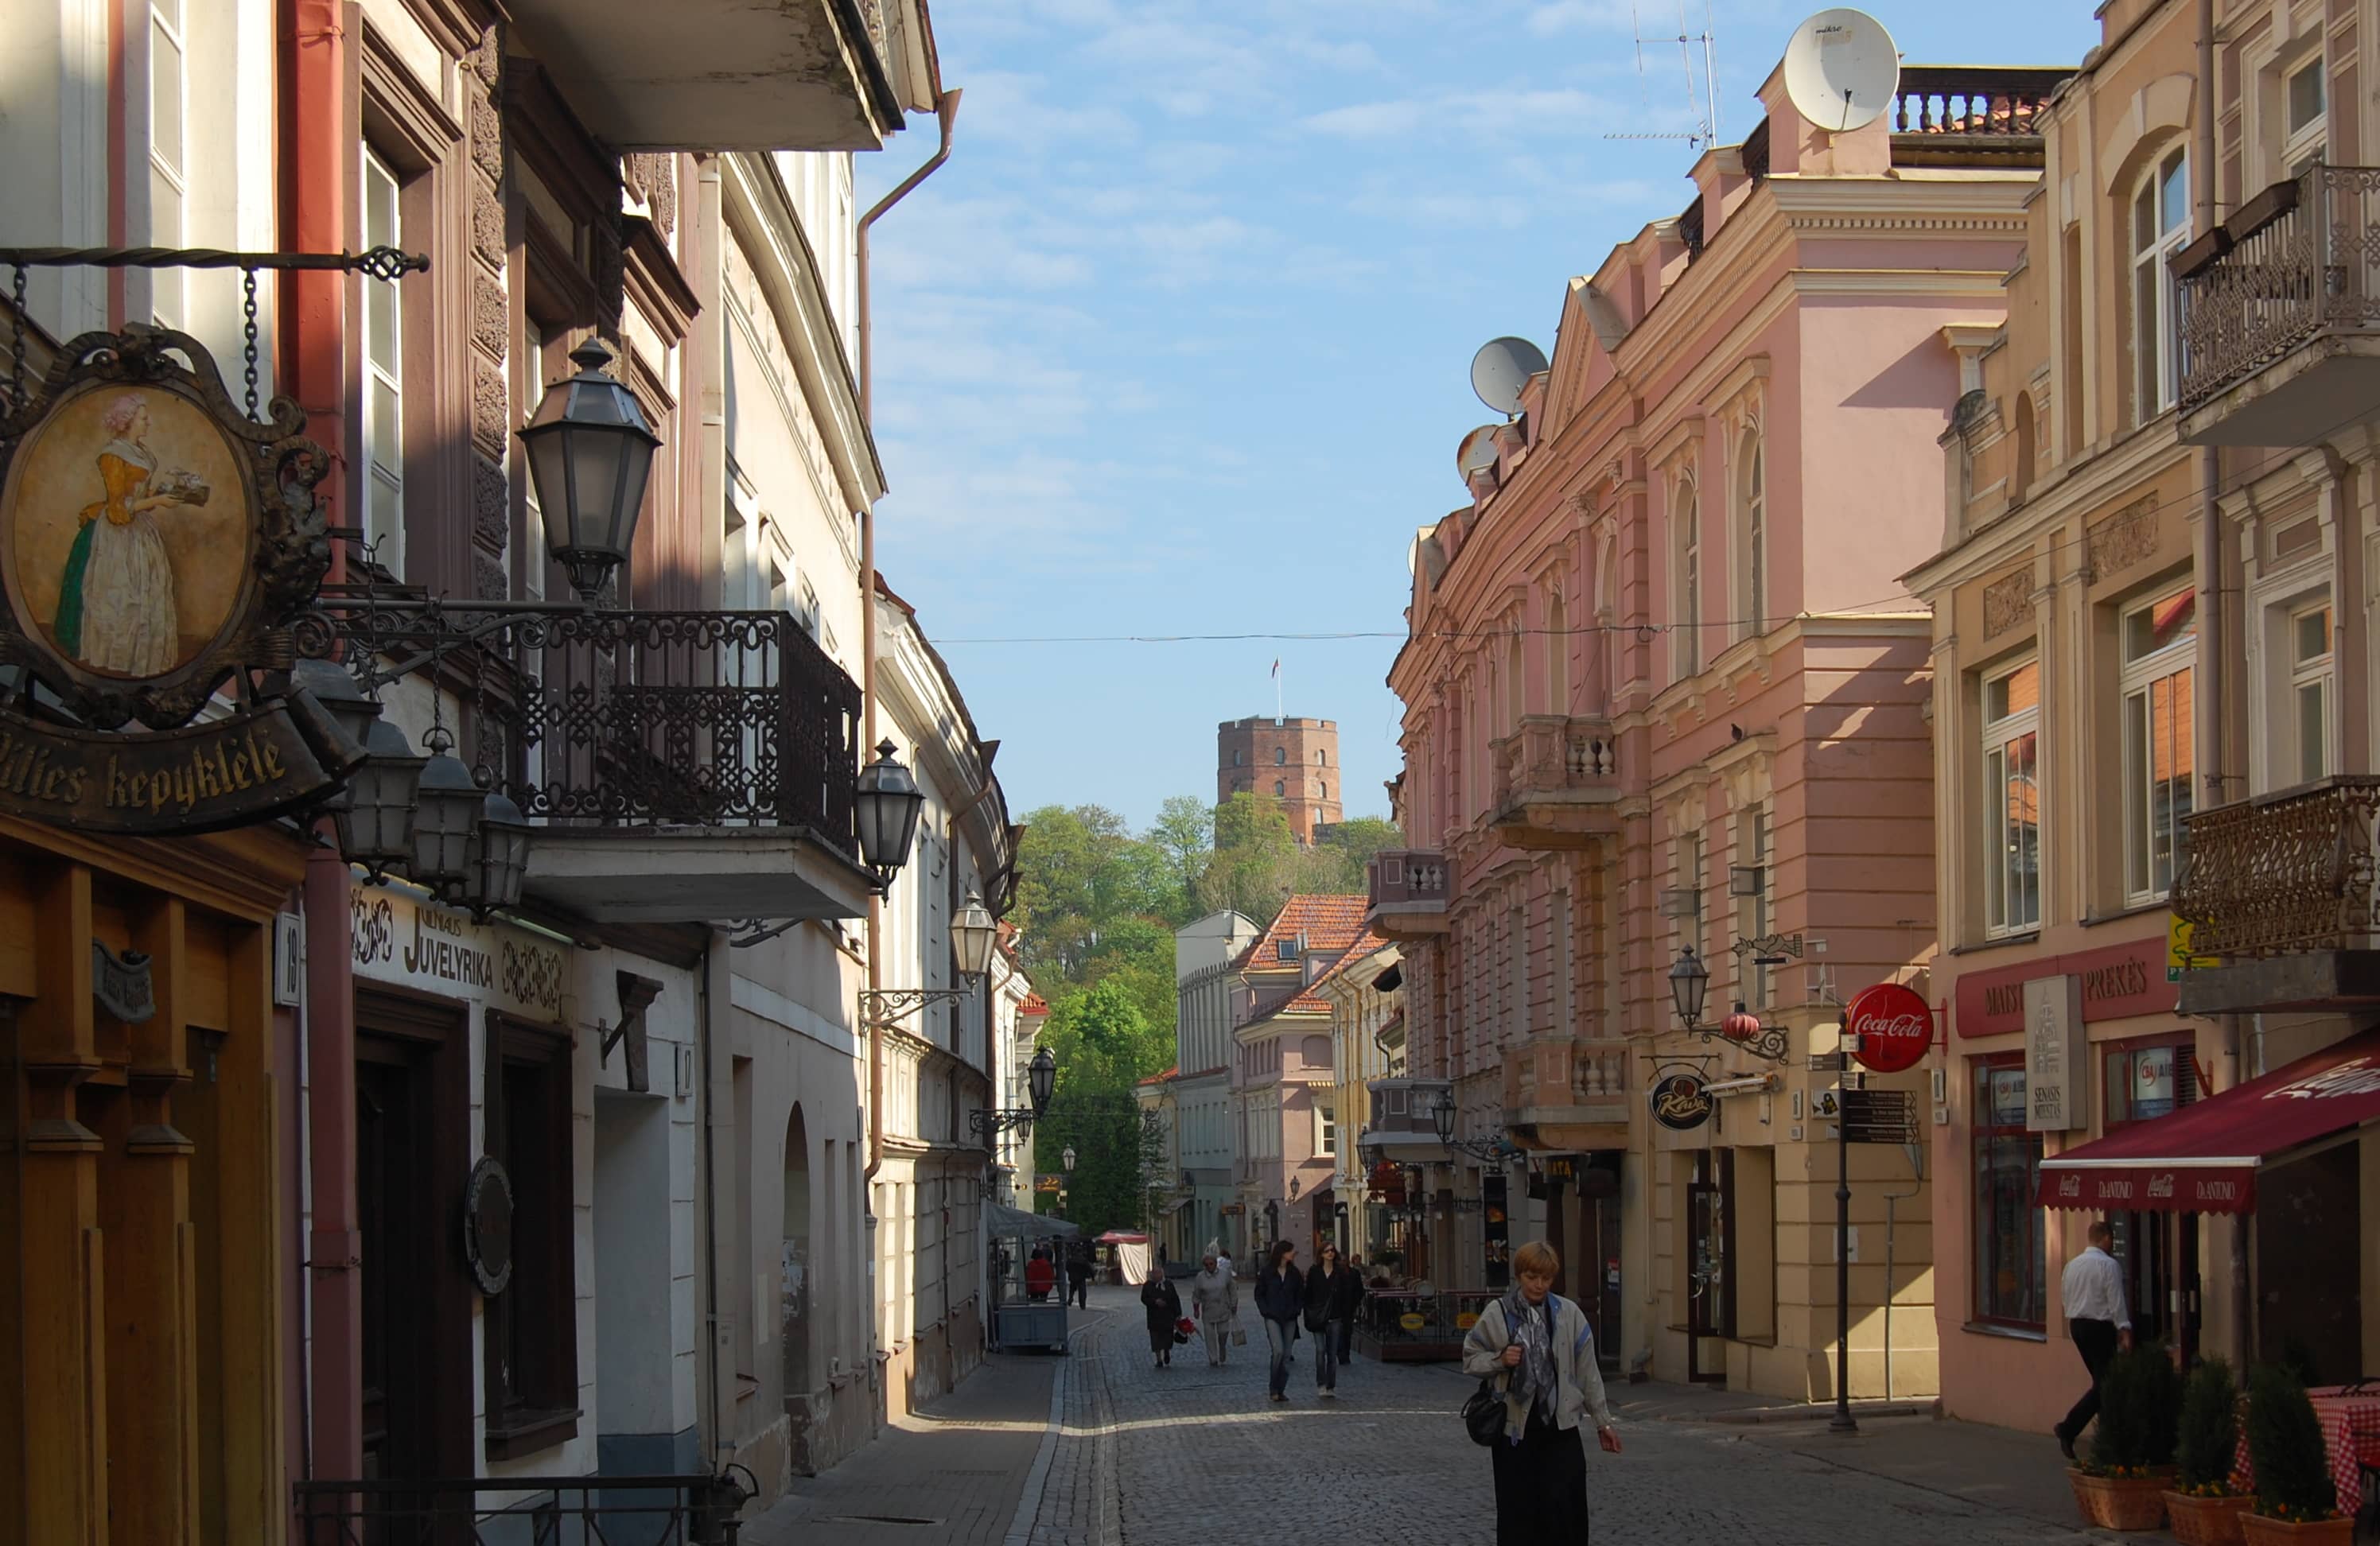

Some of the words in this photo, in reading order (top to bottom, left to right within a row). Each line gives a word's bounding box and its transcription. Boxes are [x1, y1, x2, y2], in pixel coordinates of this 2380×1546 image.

[1985, 980, 2024, 1016] MAIST
[2086, 957, 2148, 1001] PREKĖS
[1854, 1013, 1926, 1038] Coca-Cola
[1659, 1094, 1709, 1117] Kava
